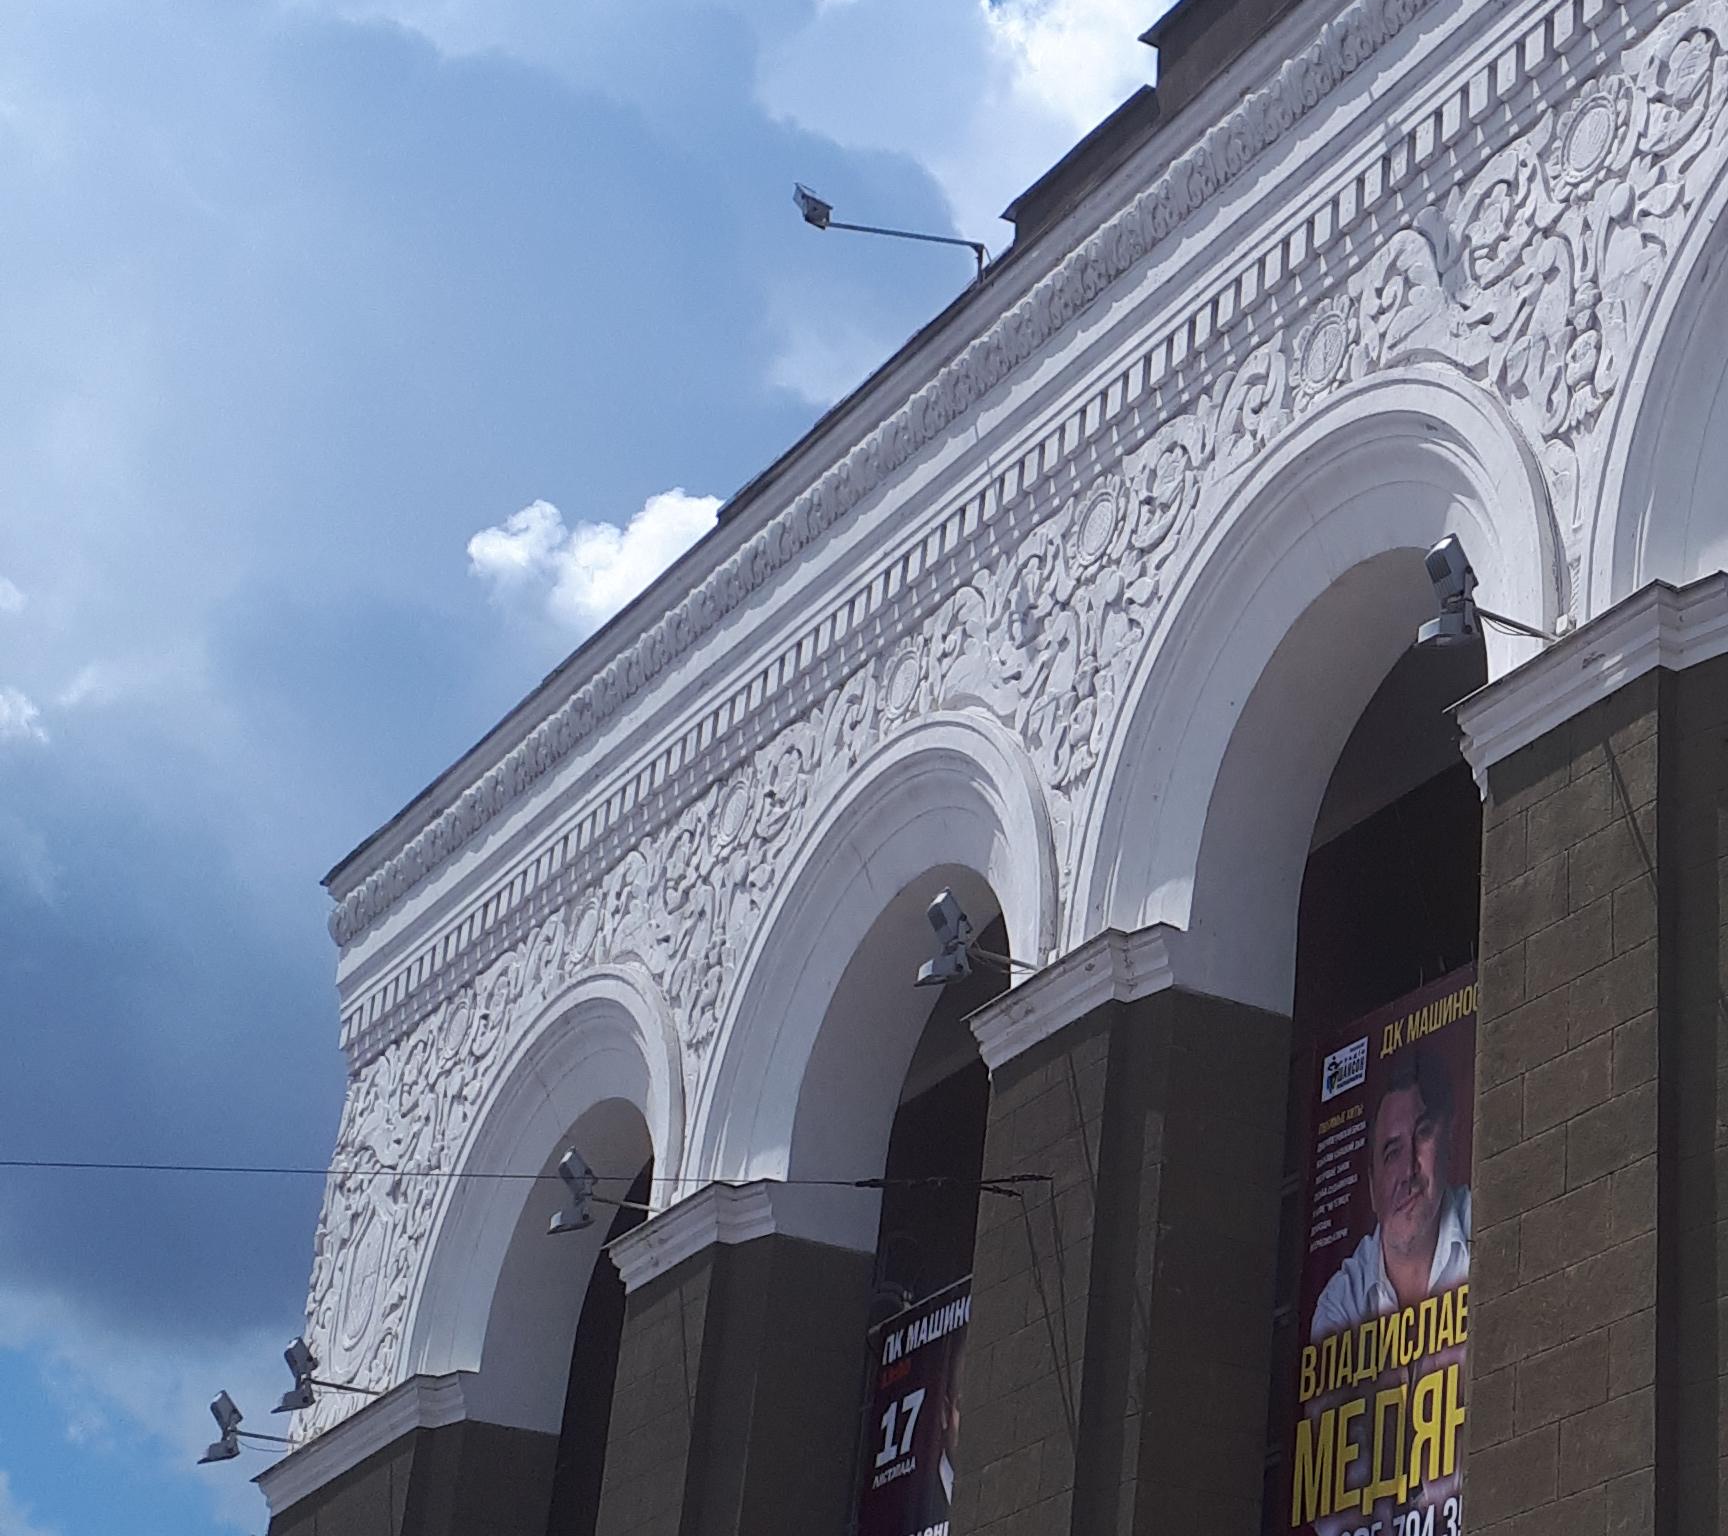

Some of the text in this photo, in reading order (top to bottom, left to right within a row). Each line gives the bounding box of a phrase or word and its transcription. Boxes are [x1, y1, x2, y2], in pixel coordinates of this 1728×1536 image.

[1380, 1017, 1405, 1059] ДК
[1299, 1284, 1470, 1403] ВЛАДИСЛАВ
[875, 1387, 926, 1469] 17
